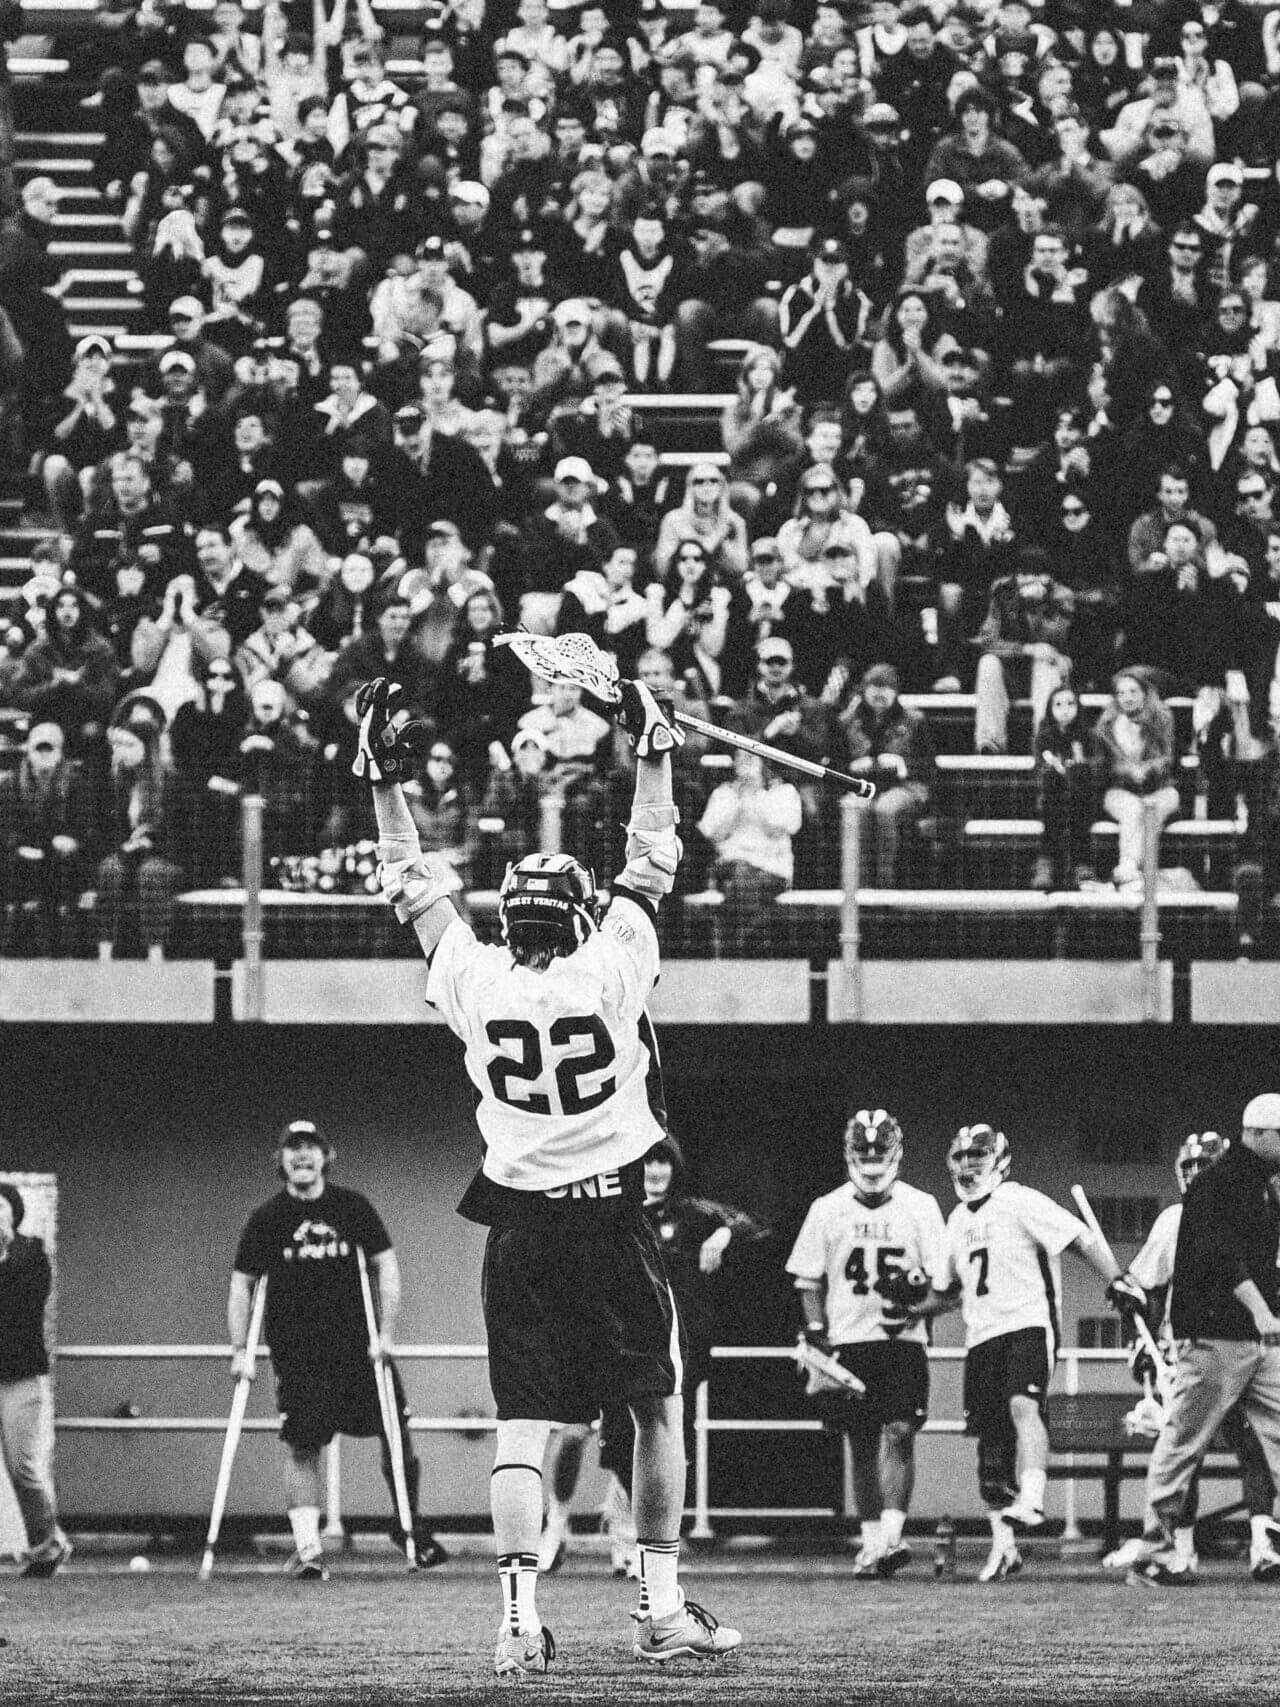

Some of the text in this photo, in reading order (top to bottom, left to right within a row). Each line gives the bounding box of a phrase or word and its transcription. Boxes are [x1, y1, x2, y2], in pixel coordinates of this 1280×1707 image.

[485, 1013, 617, 1116] 22
[844, 1247, 906, 1297] 45
[968, 1247, 990, 1297] 7
